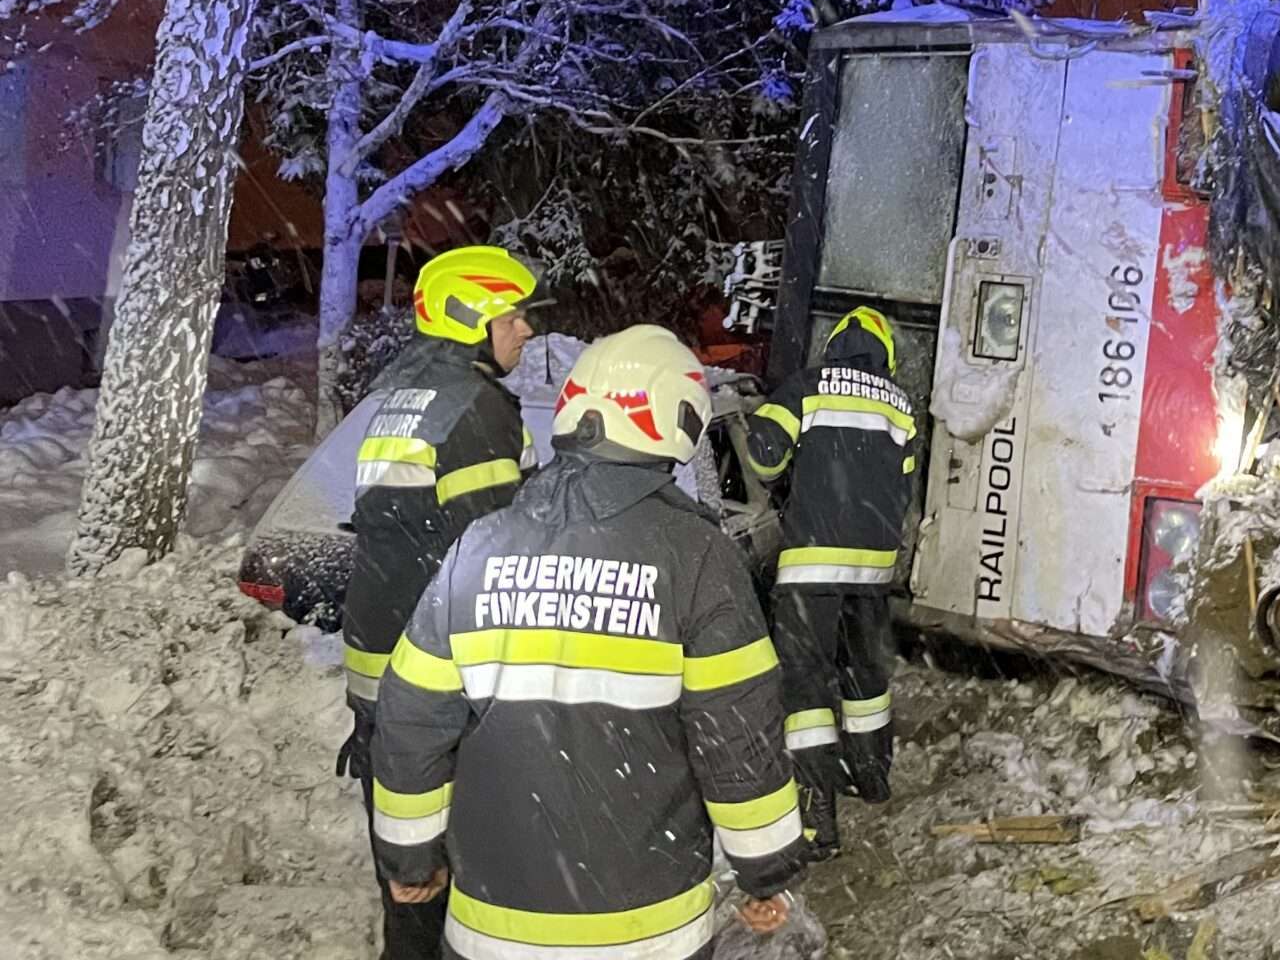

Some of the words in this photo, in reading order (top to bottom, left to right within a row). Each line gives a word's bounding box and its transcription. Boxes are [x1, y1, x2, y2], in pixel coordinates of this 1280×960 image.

[1098, 339, 1136, 403] 186
[977, 416, 1017, 602] RAILPOOL
[483, 554, 659, 600] FEUERWEHR
[474, 591, 662, 637] FINKENSTEIN
